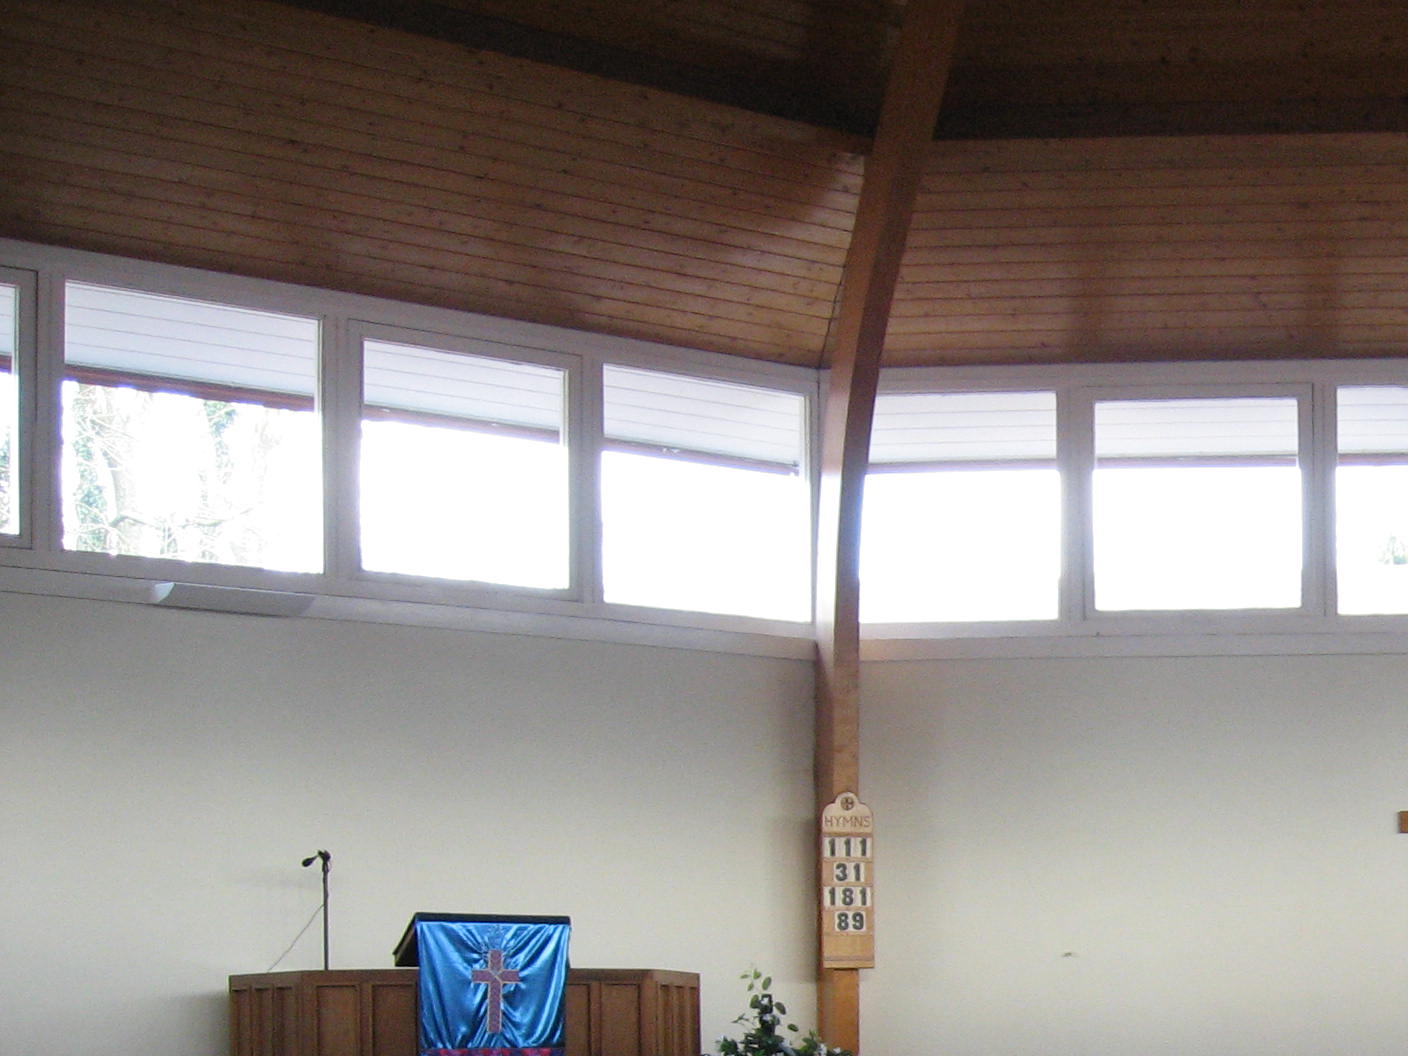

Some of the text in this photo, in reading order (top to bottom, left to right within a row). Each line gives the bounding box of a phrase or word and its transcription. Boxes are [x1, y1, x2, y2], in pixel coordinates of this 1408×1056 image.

[824, 815, 871, 828] HYMNS
[828, 838, 867, 857] 111
[835, 863, 861, 882] 31
[829, 887, 867, 906] 181
[837, 912, 865, 931] 89
